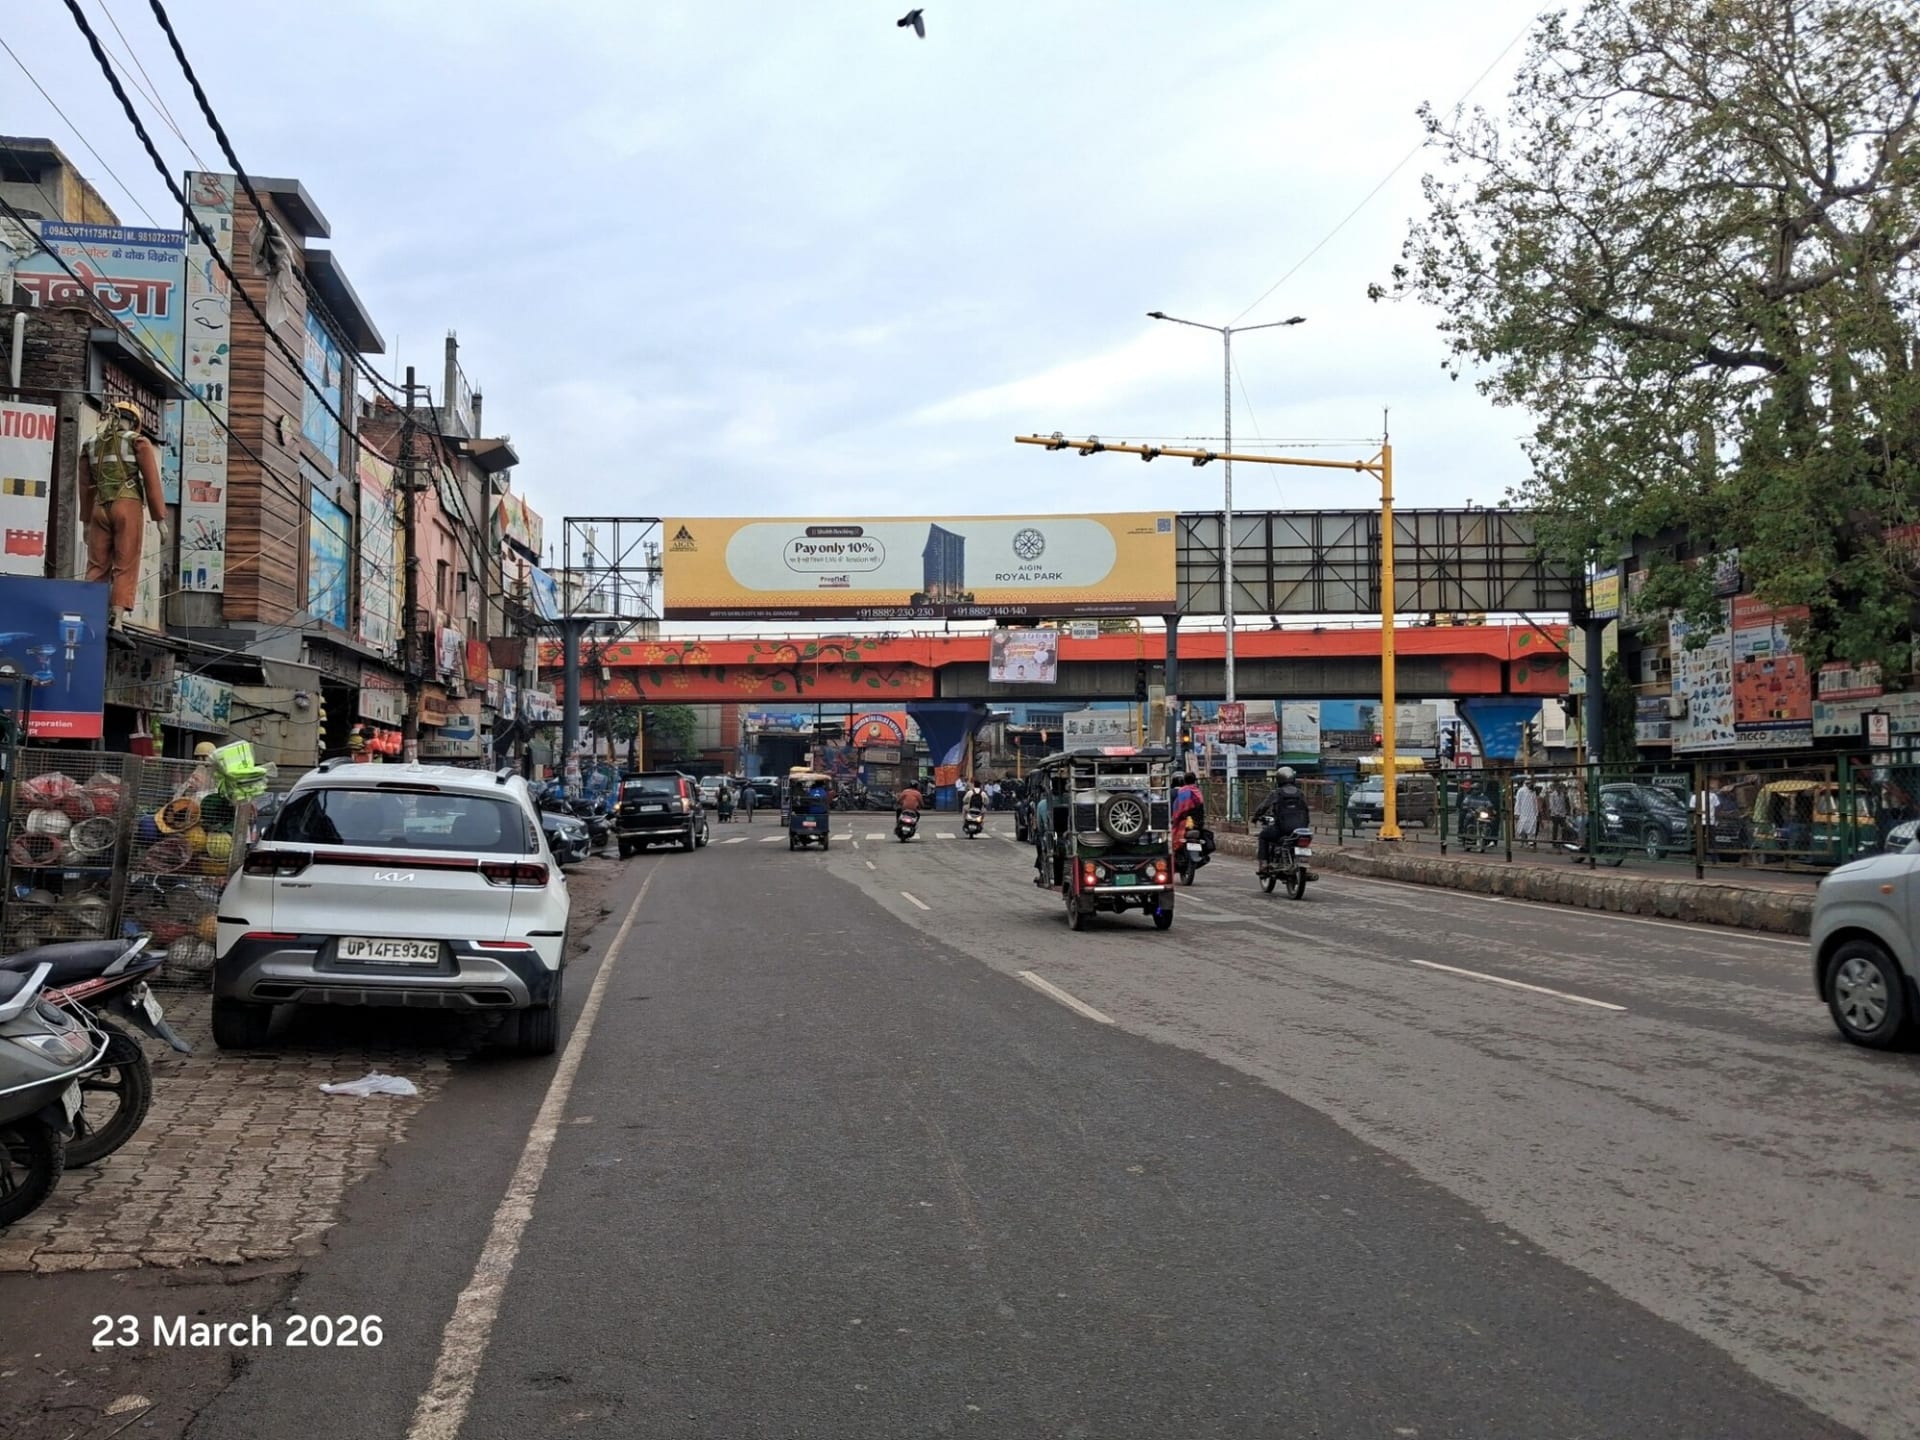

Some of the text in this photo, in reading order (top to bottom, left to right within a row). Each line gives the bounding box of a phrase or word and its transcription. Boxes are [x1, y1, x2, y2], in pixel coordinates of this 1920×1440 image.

[0, 410, 55, 441] TION
[795, 542, 874, 555] Pay only 10%
[995, 572, 1063, 581] ROYAL PARK
[347, 941, 437, 959] UP14FE9345
